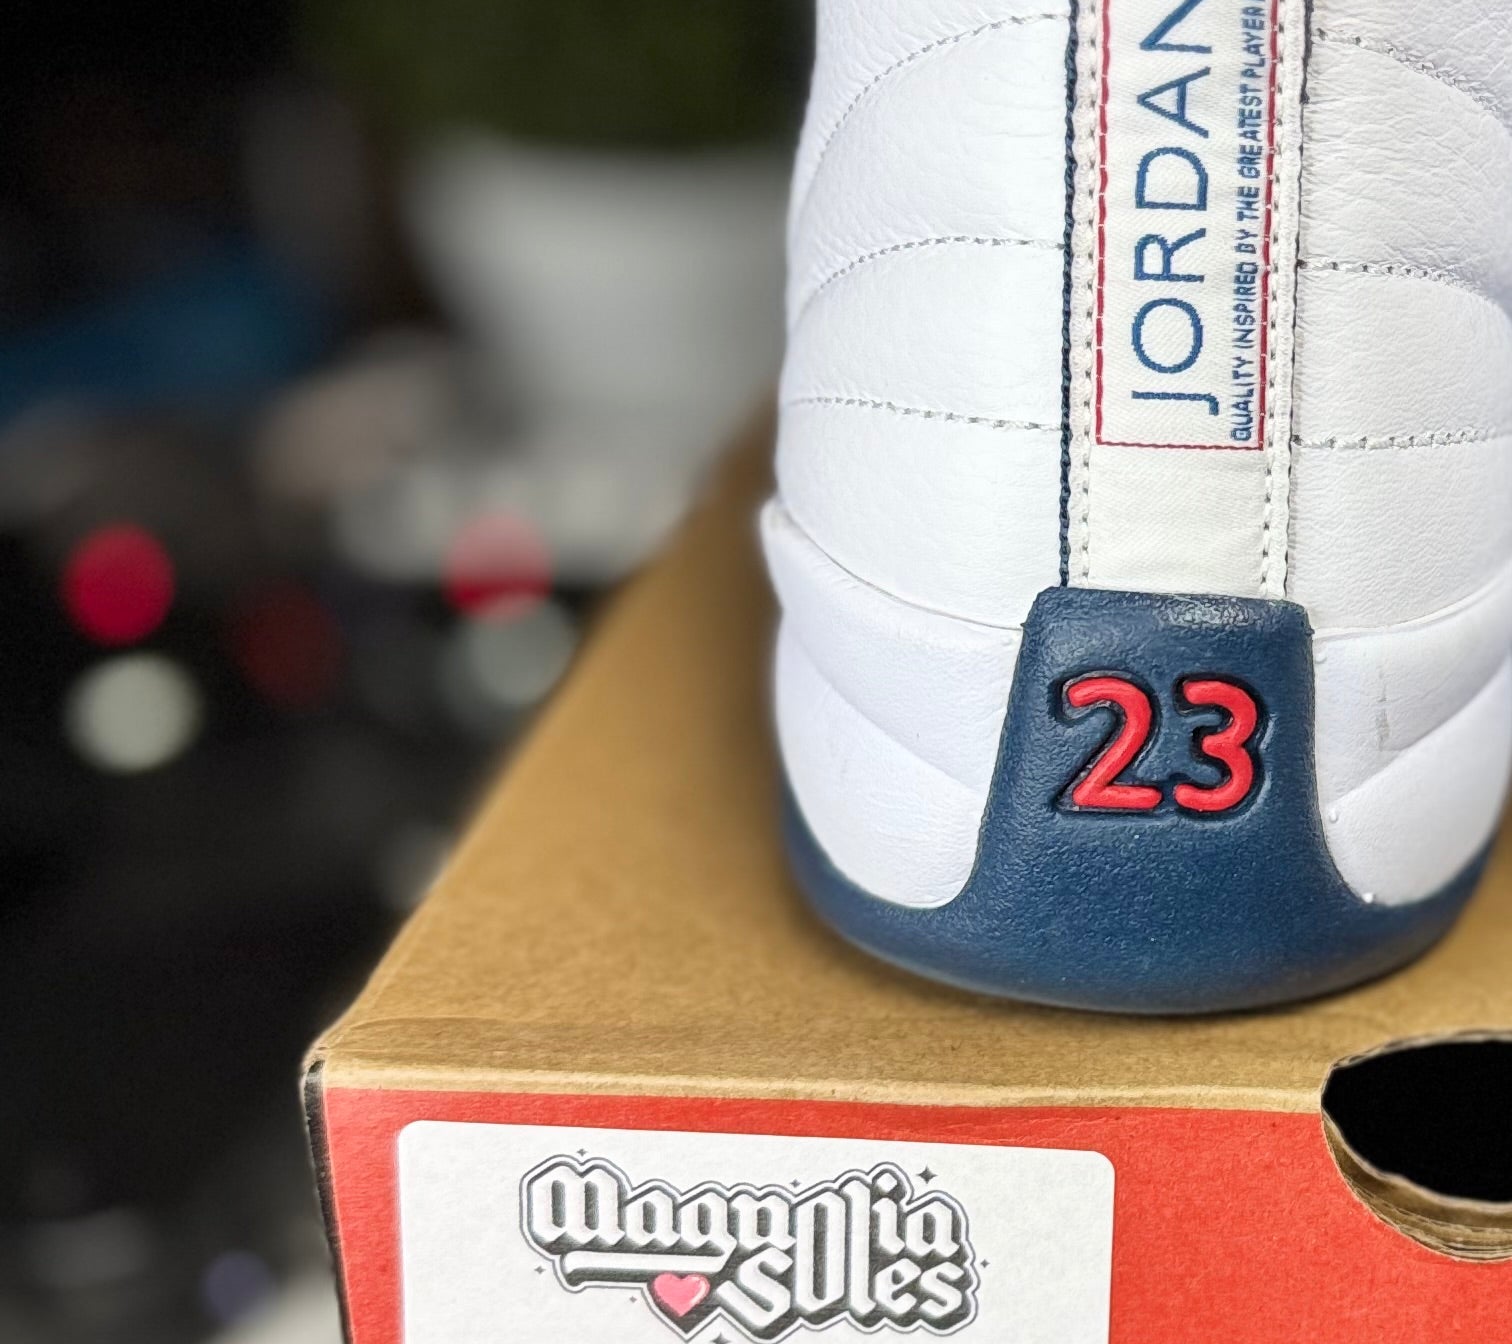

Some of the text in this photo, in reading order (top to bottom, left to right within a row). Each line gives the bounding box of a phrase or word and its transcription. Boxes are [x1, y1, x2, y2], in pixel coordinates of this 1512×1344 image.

[1240, 7, 1266, 78] PLAYER
[1237, 84, 1263, 180] GREATEST
[1234, 229, 1258, 254] BY
[1236, 186, 1260, 222] THE
[1232, 261, 1259, 349] INSPIRED
[1230, 356, 1255, 441] QUALITY
[1063, 674, 1259, 813] 23
